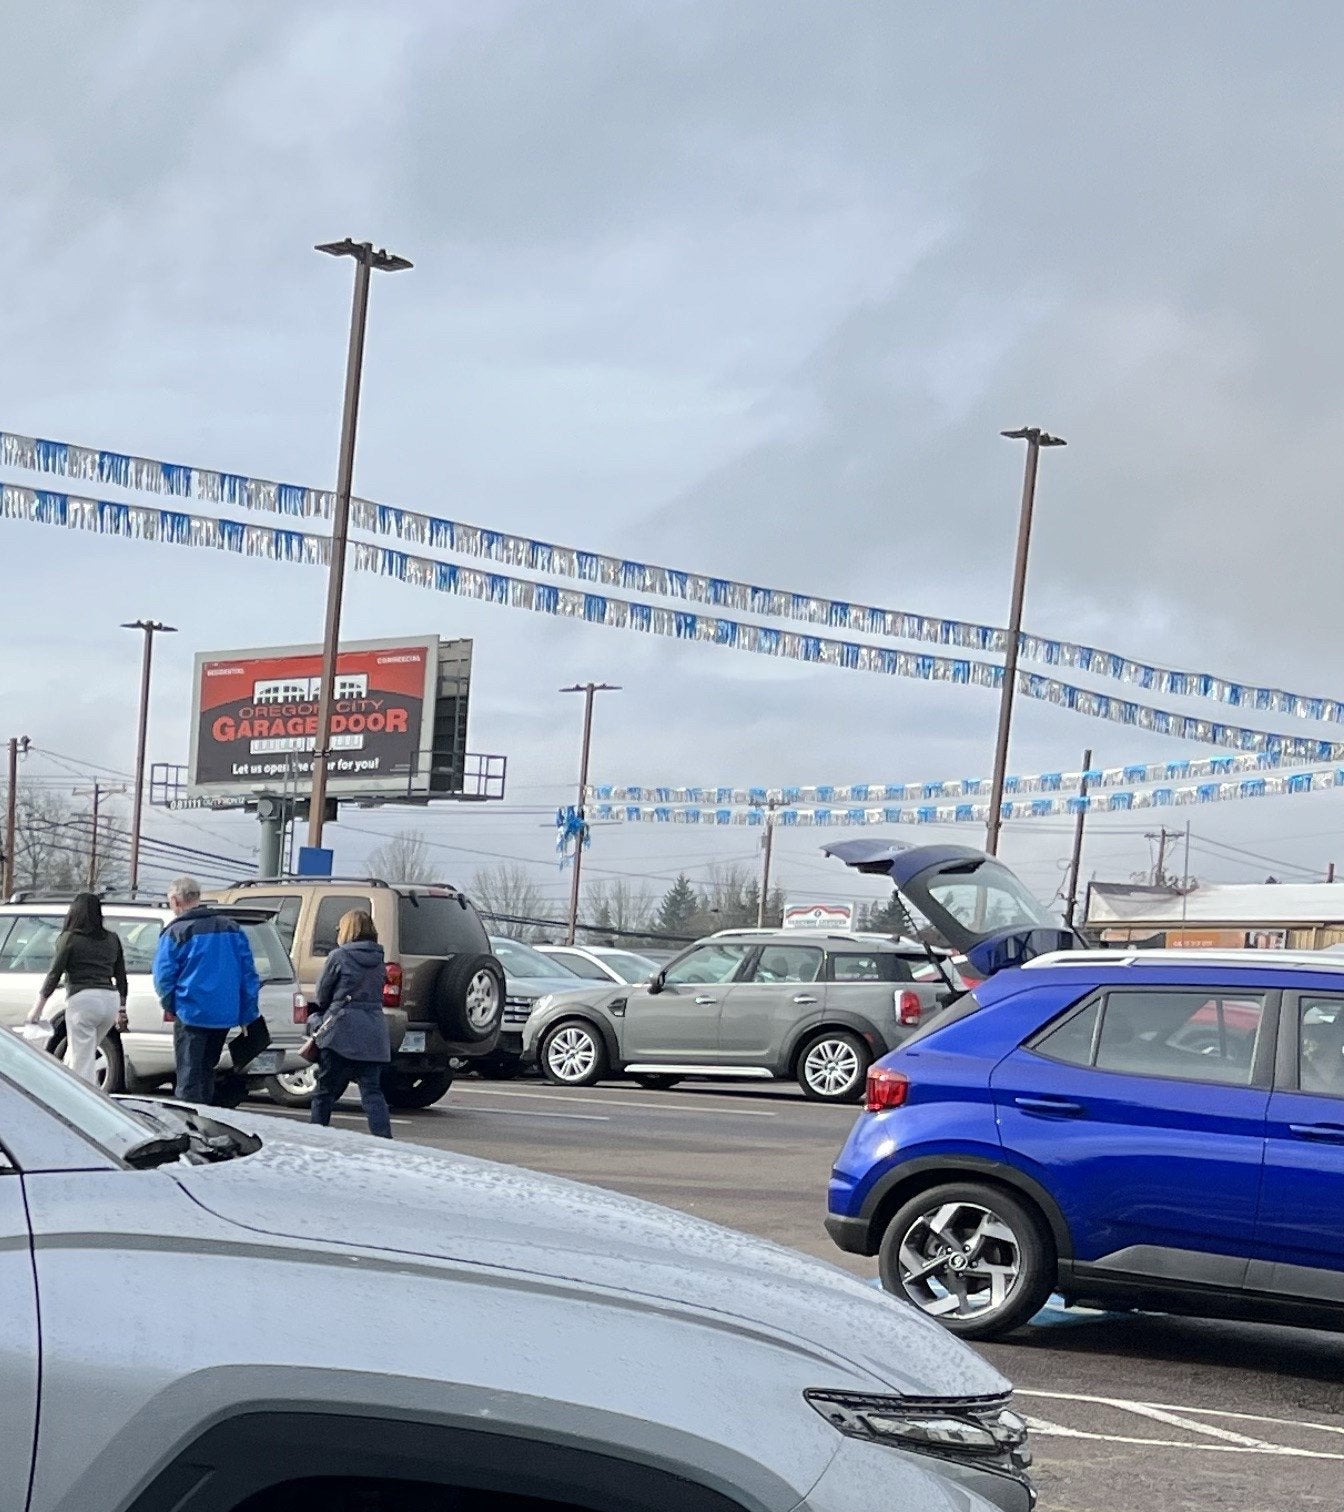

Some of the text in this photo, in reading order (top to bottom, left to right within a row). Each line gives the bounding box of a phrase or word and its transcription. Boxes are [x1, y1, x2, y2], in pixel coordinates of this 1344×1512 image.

[335, 699, 385, 713] CITY
[213, 708, 408, 742] GARAGE DOOR
[232, 763, 249, 775] Let
[250, 763, 263, 774] us
[263, 762, 289, 776] open
[337, 758, 353, 770] for
[354, 756, 380, 772] you!
